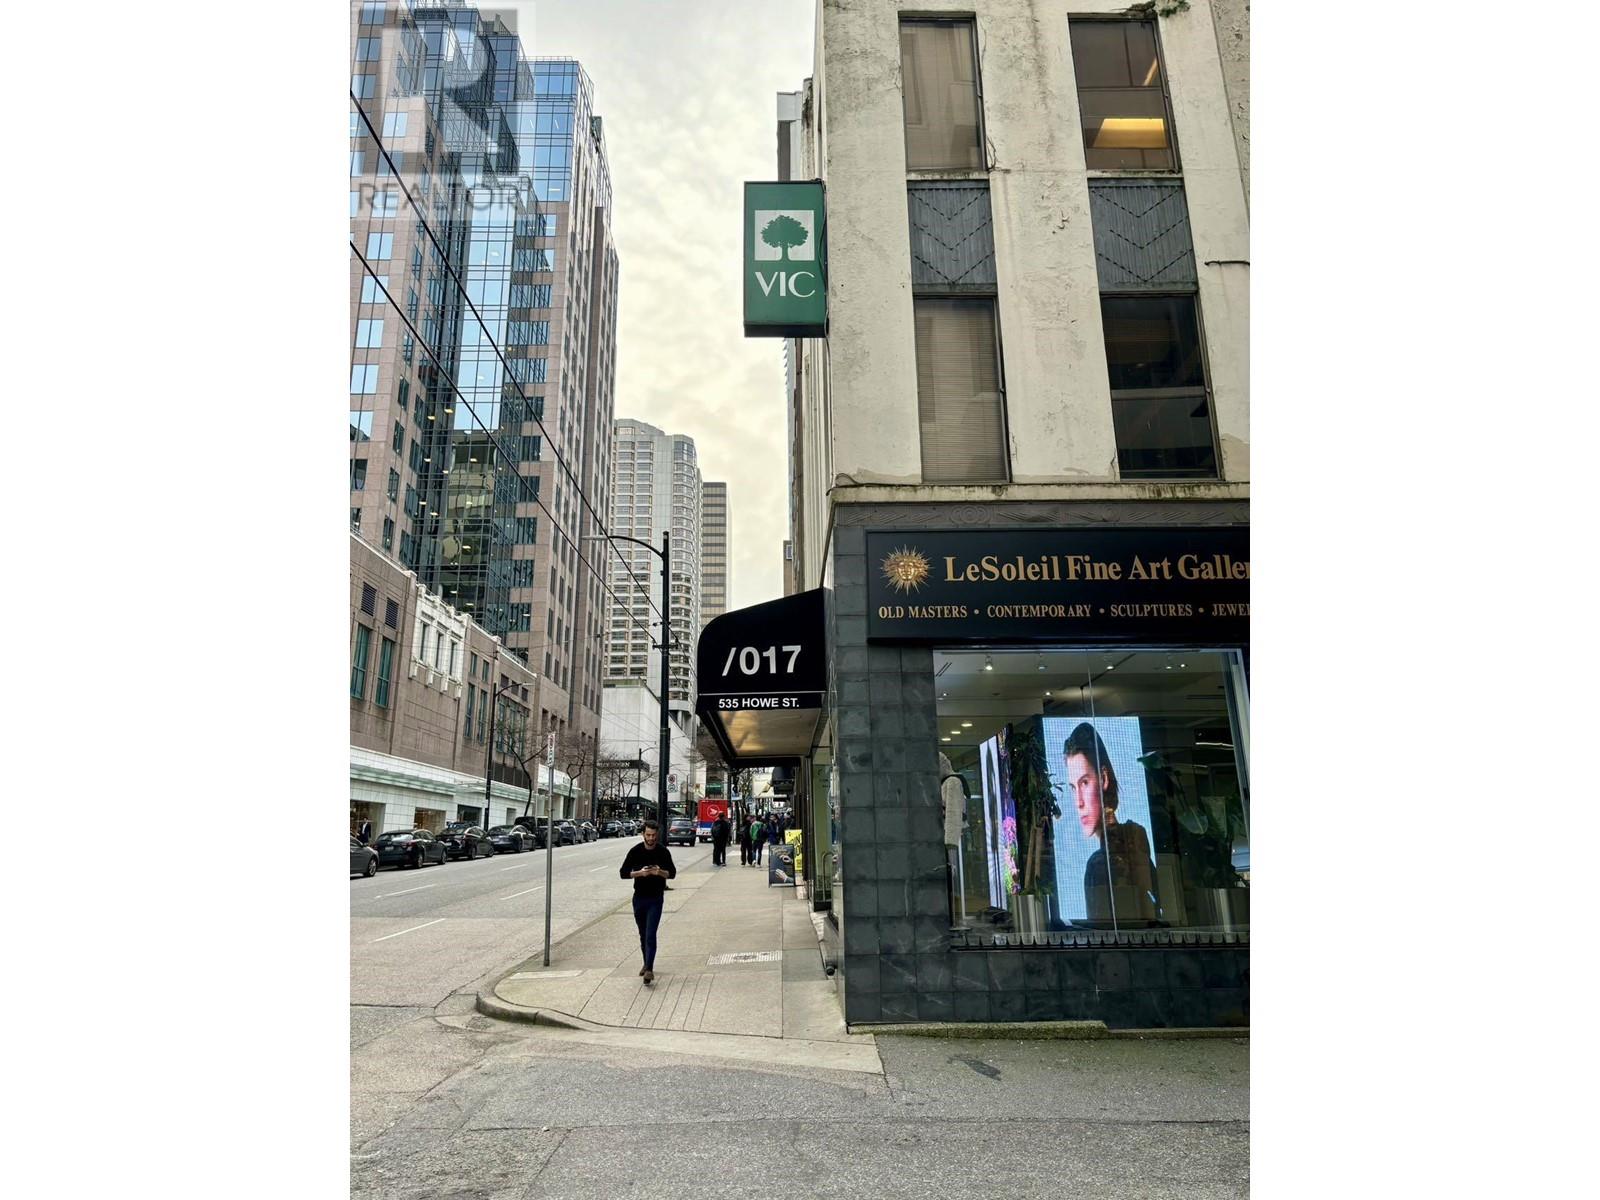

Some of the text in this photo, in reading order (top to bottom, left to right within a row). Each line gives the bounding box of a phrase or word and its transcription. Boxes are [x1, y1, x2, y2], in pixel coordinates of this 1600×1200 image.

[754, 271, 816, 298] VIC
[944, 555, 1060, 582] LeSoleil
[1065, 554, 1122, 580] Fine
[1128, 555, 1172, 580] Art
[878, 606, 905, 619] OLD
[908, 605, 968, 618] MASTERS
[987, 604, 1091, 618] CONTEMPORARY
[1110, 603, 1193, 617] SCULPTURES
[722, 645, 801, 676] /017
[718, 697, 800, 709] 535 HOWE ST.
